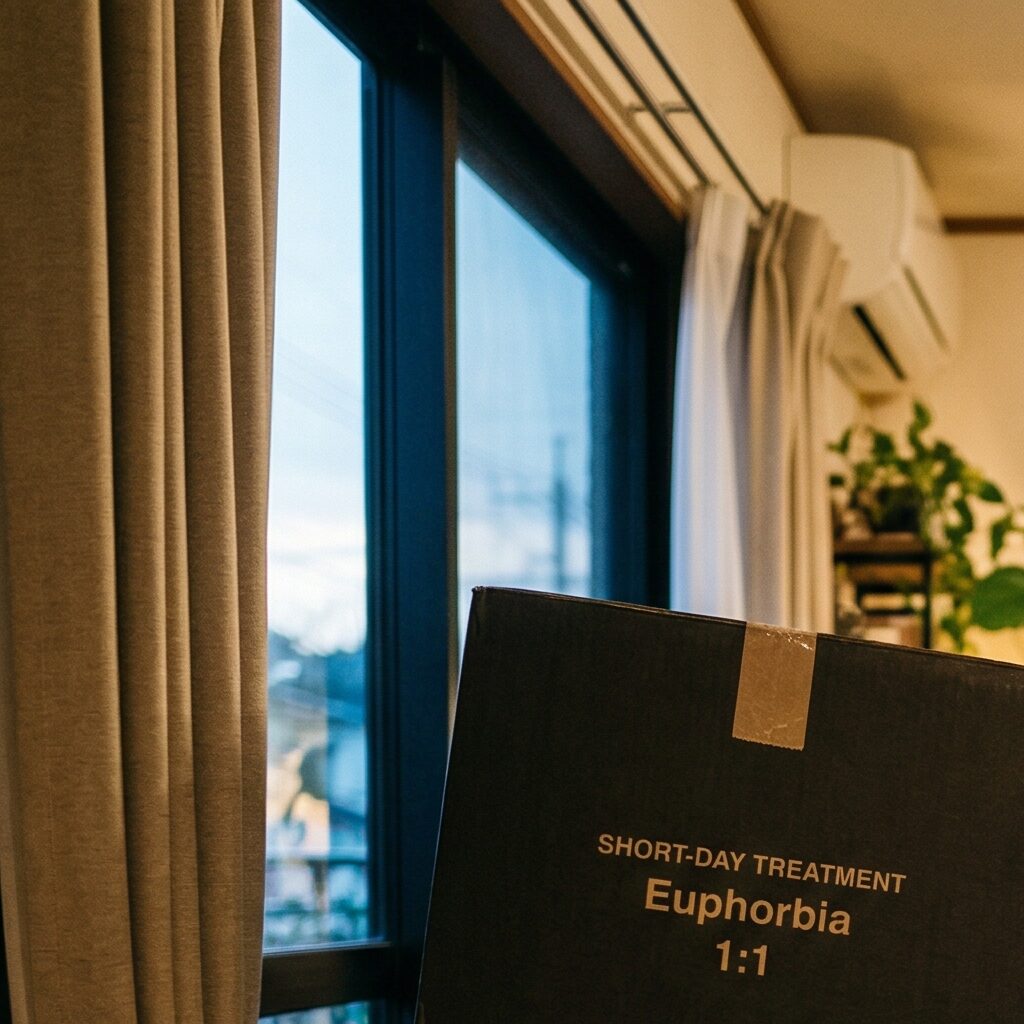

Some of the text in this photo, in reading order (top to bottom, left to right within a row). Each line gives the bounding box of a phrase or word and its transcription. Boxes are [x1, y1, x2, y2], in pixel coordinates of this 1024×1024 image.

[598, 834, 906, 893] SHORT-DAY TREATMENT
[645, 878, 850, 935] Euphorbia
[717, 940, 767, 976] 1:1
